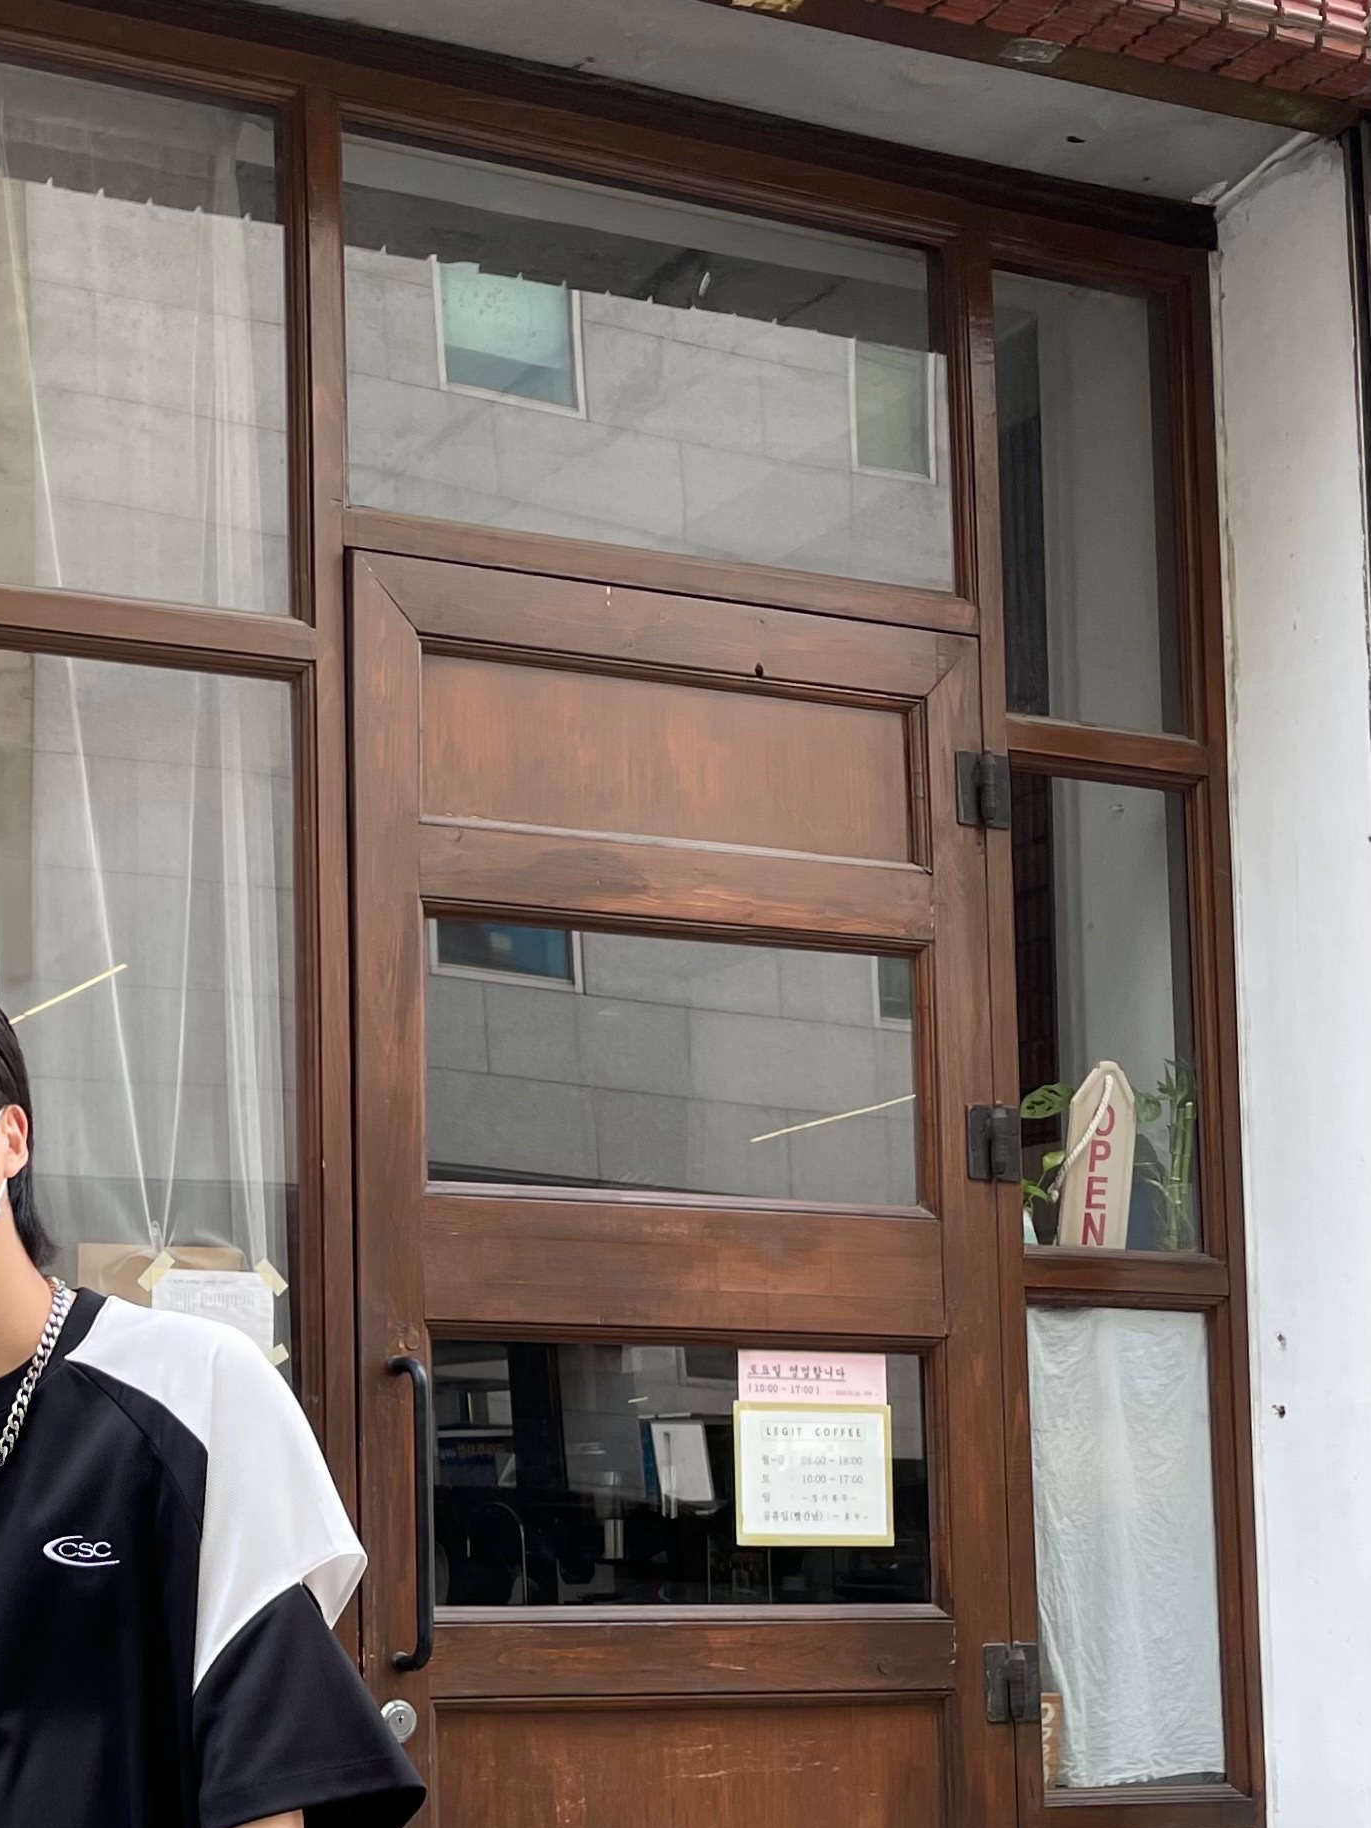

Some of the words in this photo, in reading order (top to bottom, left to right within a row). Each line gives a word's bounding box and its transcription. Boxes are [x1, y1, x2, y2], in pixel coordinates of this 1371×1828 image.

[1081, 1103, 1115, 1246] OPEN
[748, 1363, 781, 1377] 토요일
[789, 1365, 846, 1380] 영업합니다
[766, 1426, 803, 1437] LEGIT
[815, 1427, 862, 1438] COFFEE
[802, 1474, 827, 1484] 10:00
